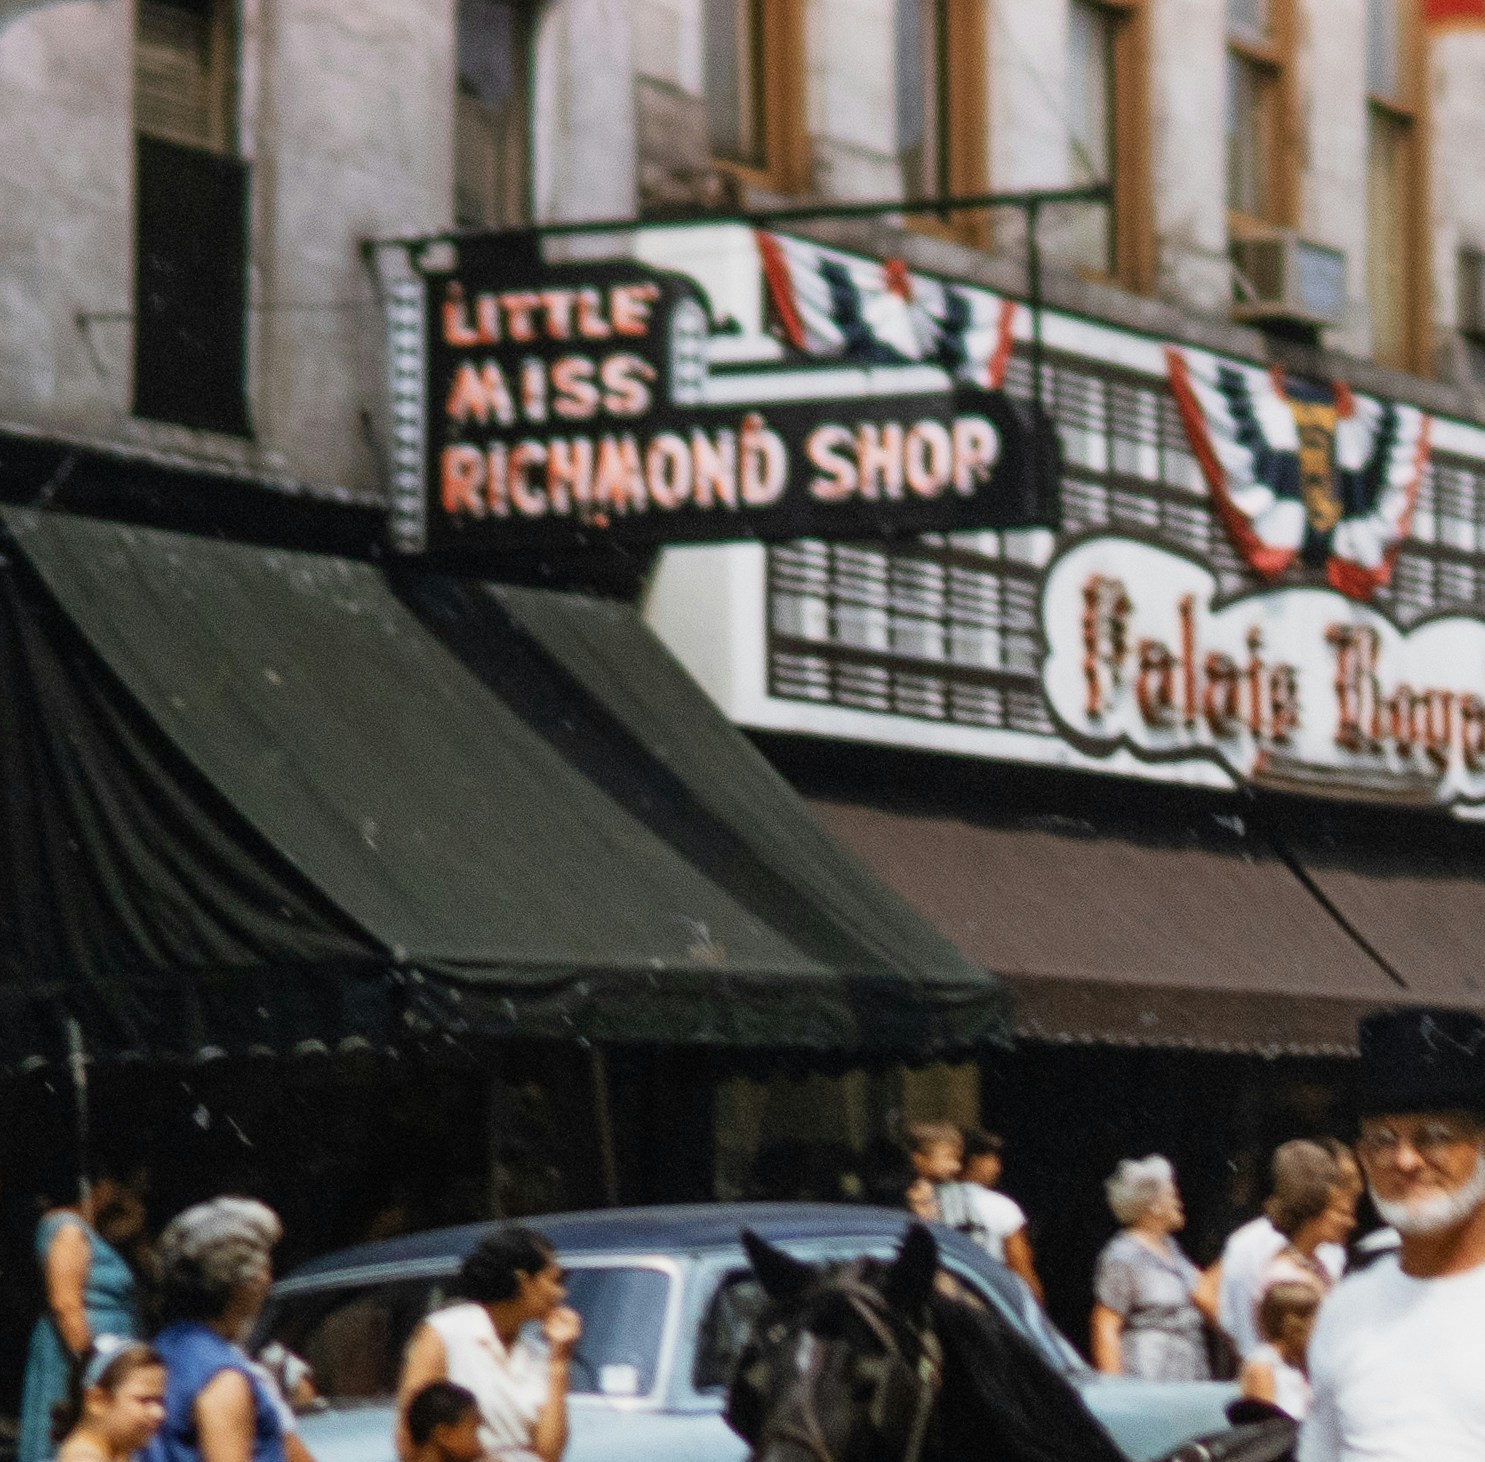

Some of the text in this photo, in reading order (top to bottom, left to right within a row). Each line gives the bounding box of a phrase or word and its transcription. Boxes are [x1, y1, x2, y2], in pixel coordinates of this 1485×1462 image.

[444, 283, 659, 347] LITTLE
[446, 352, 657, 424] MISS
[440, 416, 999, 516] RICHMOND SHOP
[1081, 574, 1299, 748] Palais
